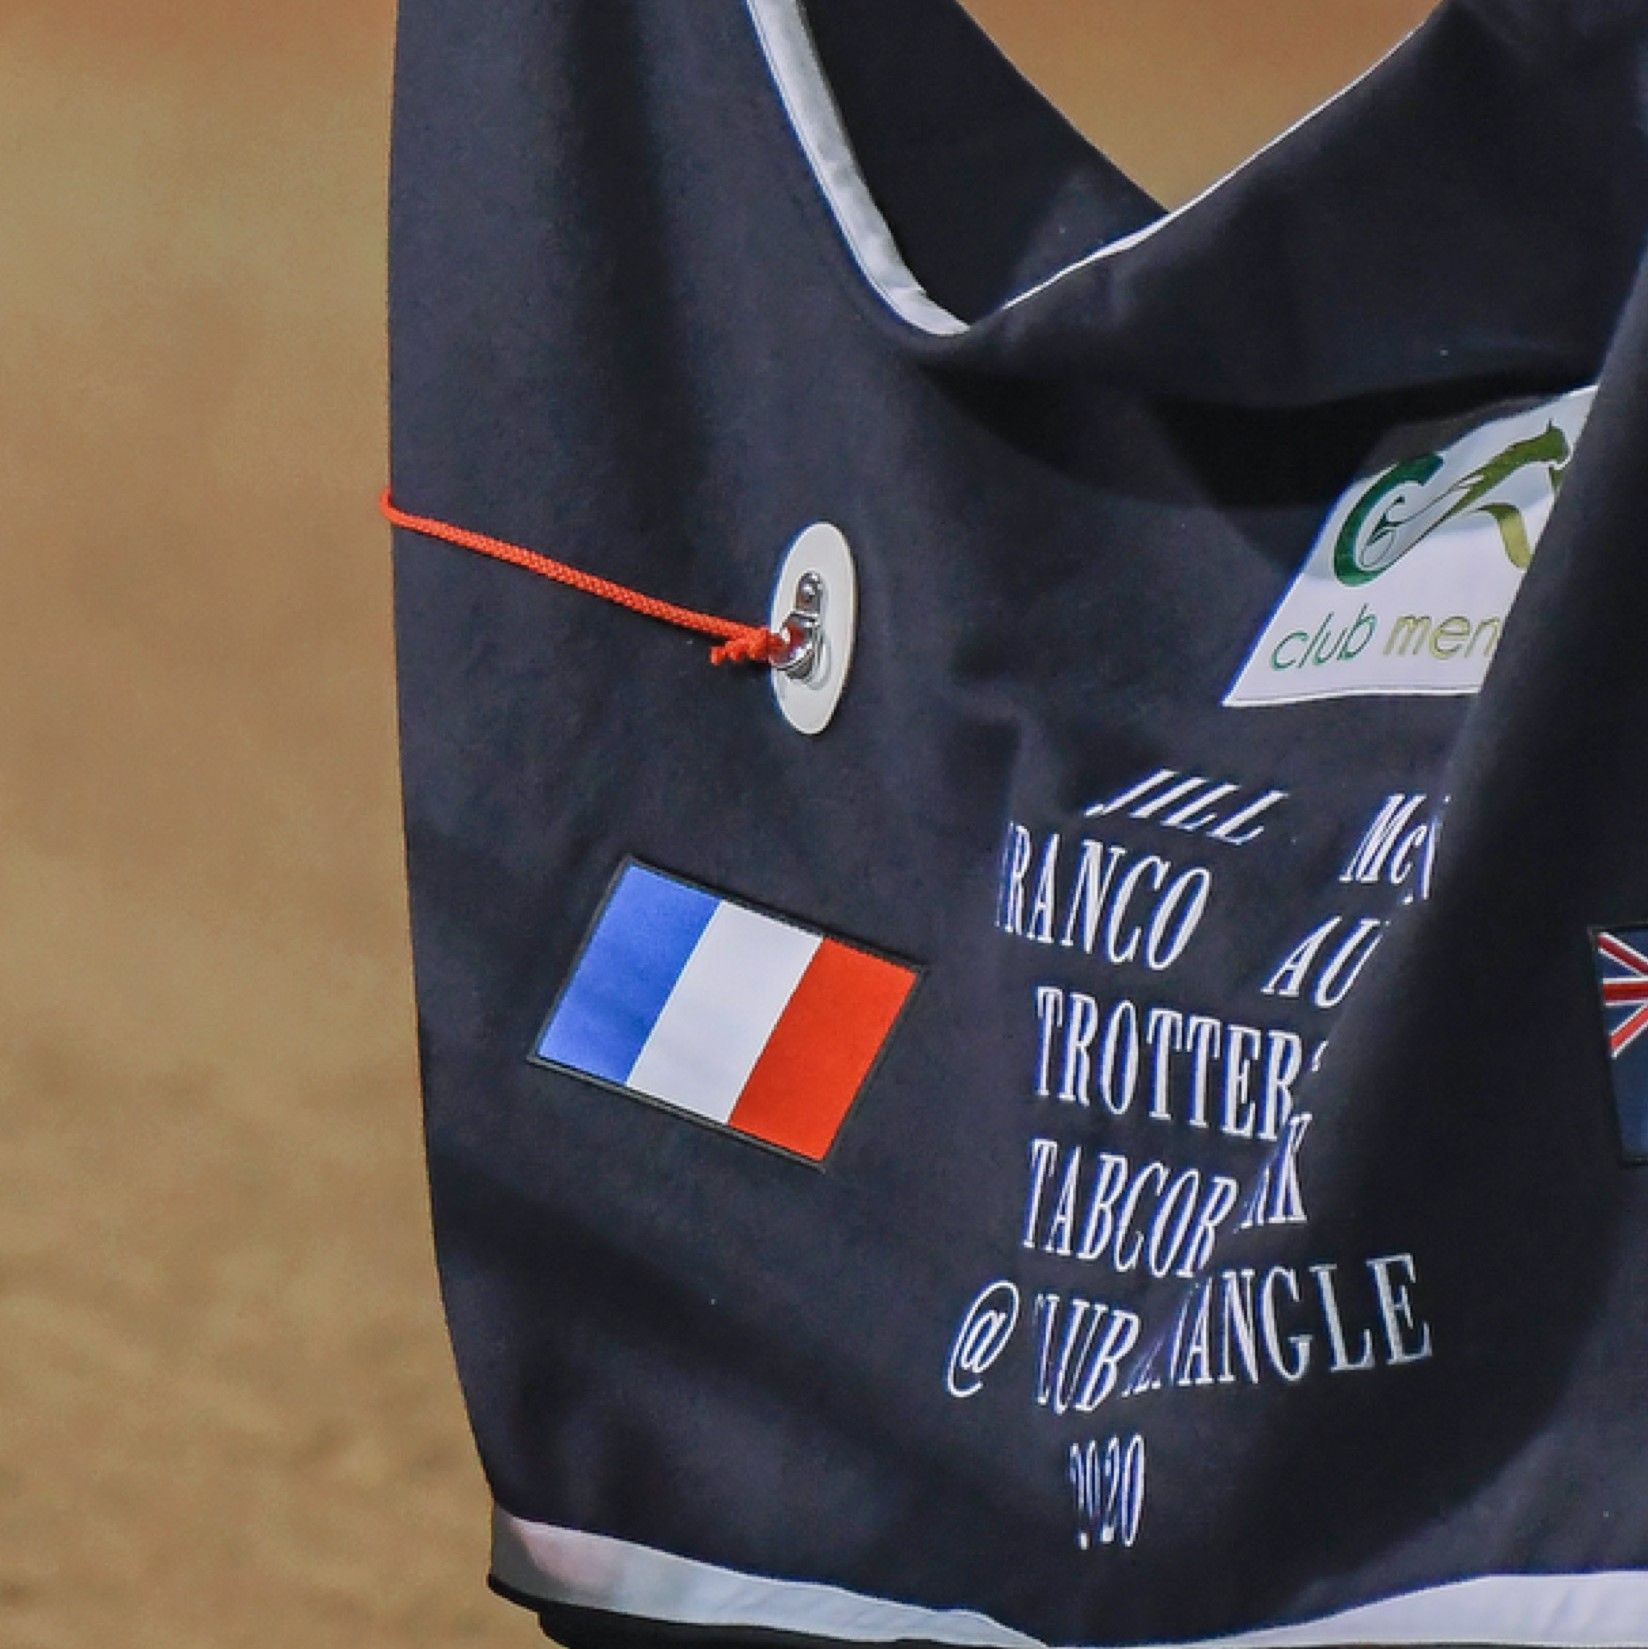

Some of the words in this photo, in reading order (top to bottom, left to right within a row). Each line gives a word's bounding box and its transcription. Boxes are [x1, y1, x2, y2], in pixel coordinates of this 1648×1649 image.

[1270, 602, 1378, 672] club
[994, 820, 1212, 971] RANCO
[1084, 768, 1291, 846] JILL
[1337, 792, 1452, 906] Mc
[1034, 985, 1329, 1143] TROTTER
[1121, 1252, 1433, 1399] ANGLE
